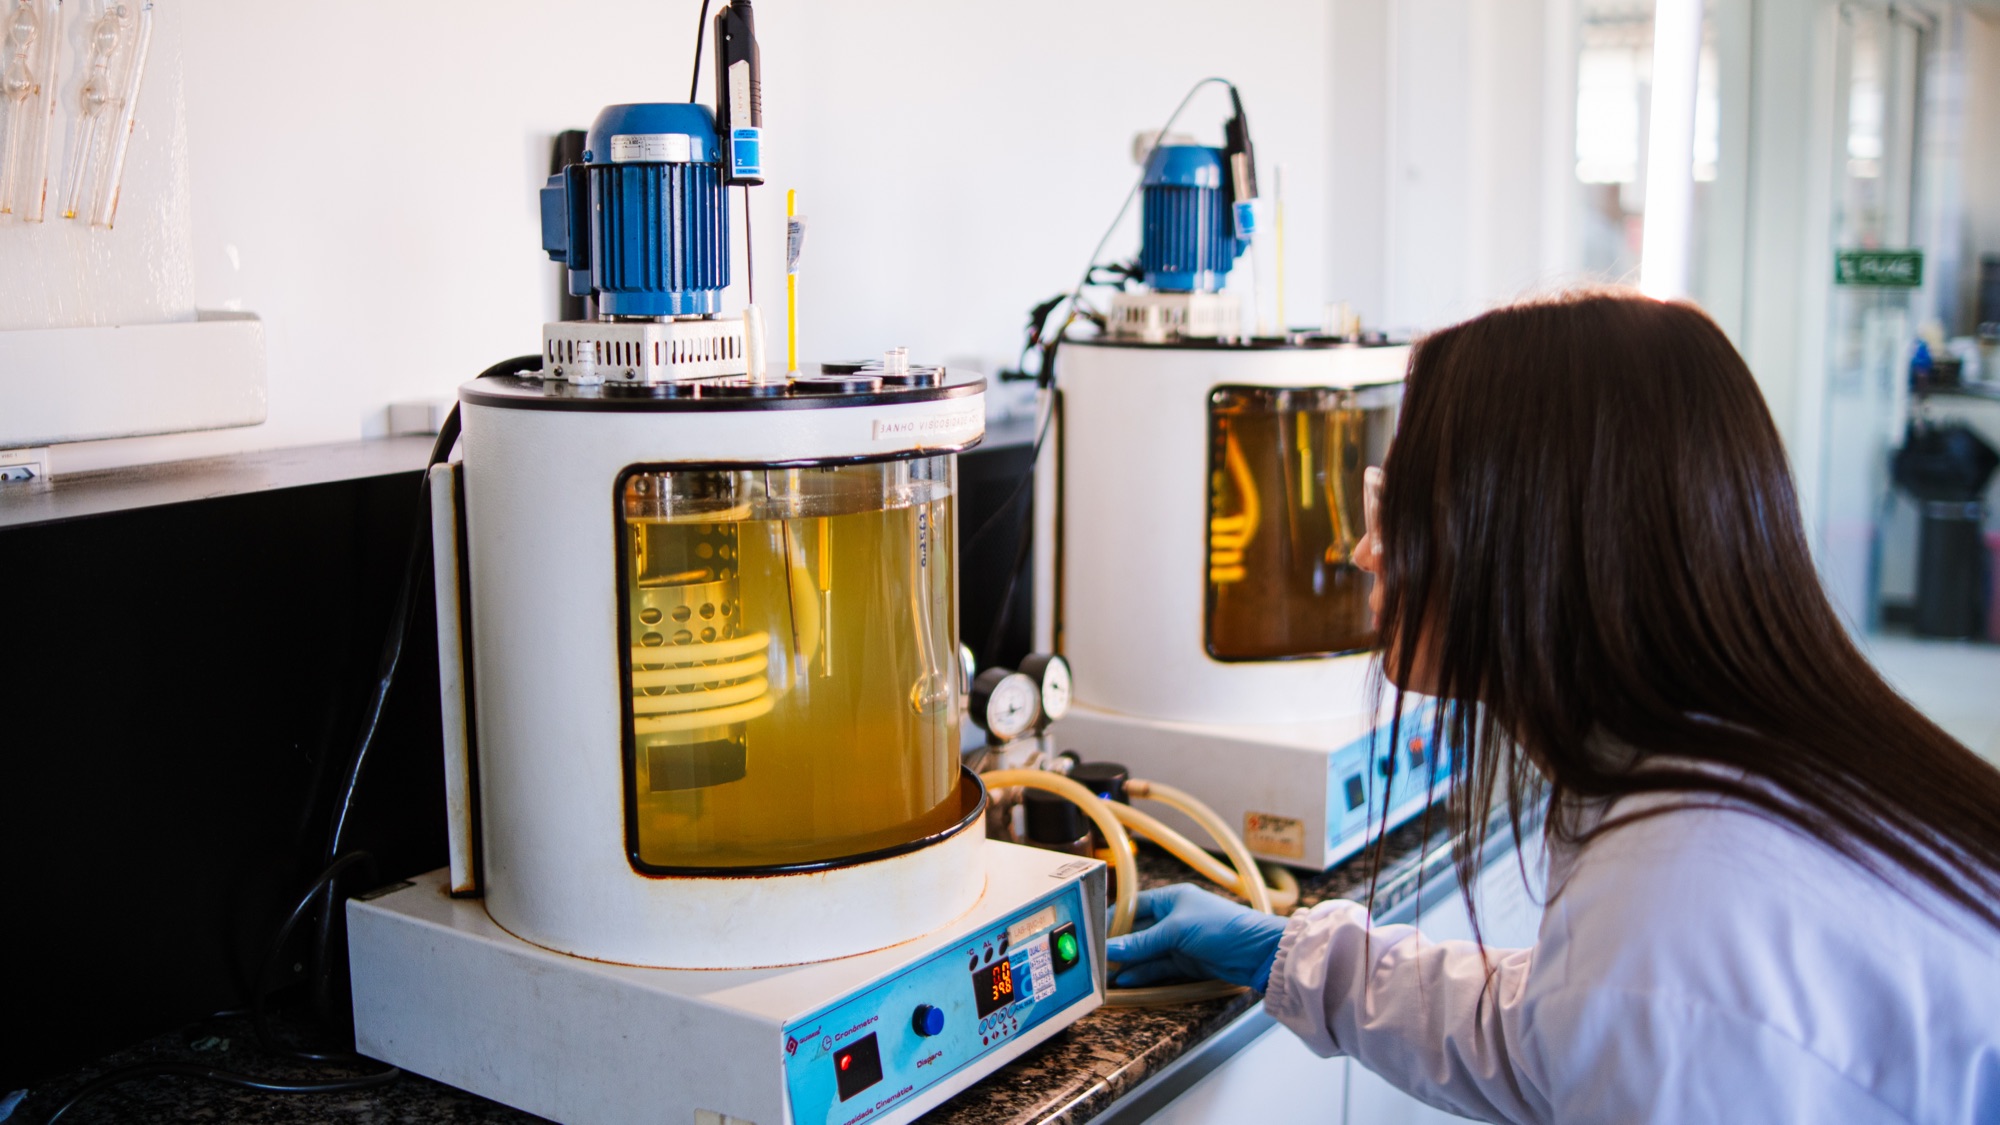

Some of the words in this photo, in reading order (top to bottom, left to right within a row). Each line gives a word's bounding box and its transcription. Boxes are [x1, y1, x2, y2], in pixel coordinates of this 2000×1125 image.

[834, 1015, 879, 1041] Cronômetro
[916, 1050, 943, 1068] Disparo
[875, 1084, 914, 1110] Cinemática
